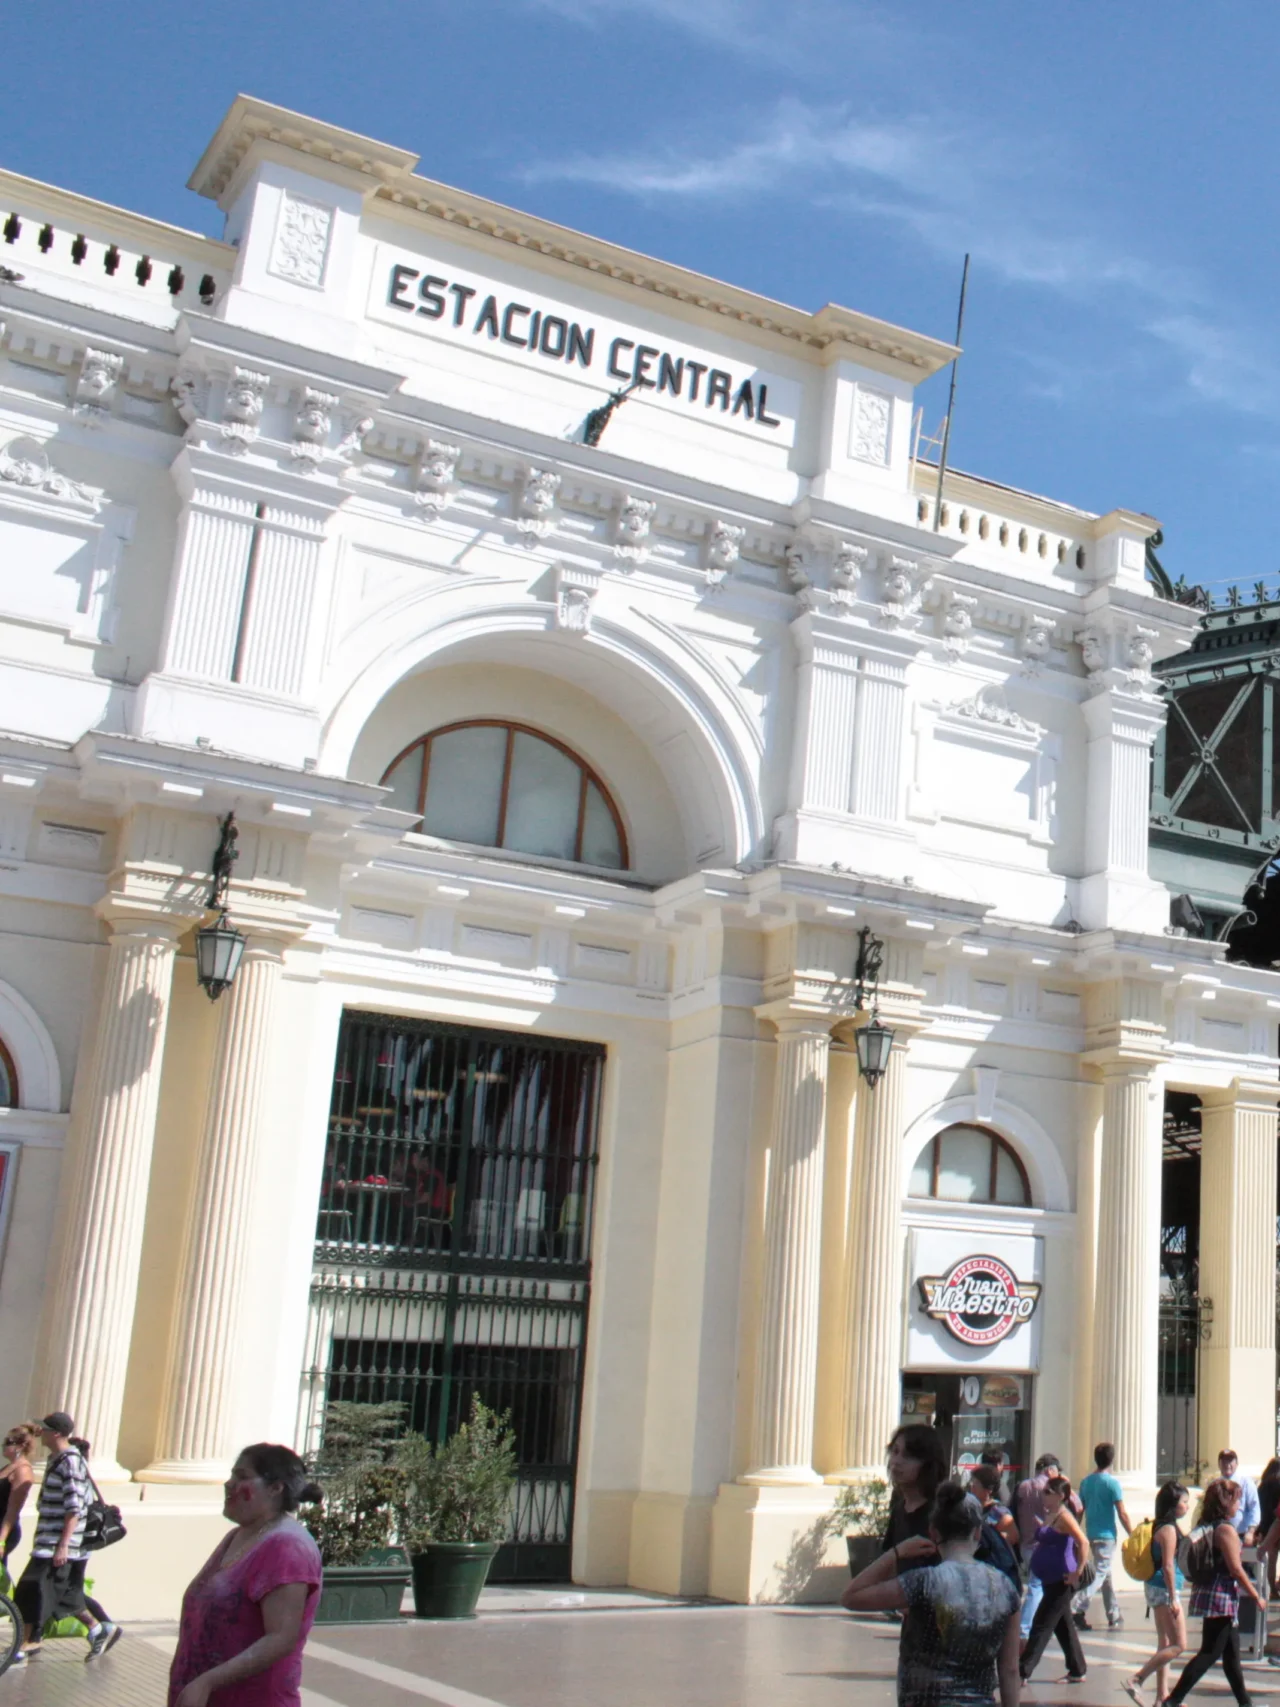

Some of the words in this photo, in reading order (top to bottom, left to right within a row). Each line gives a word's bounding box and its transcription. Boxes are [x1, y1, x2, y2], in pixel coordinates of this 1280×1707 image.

[389, 263, 595, 367] ESTACION
[608, 337, 781, 427] CENTRAL
[952, 1260, 1012, 1286] ESPECIALISTA
[958, 1276, 1004, 1296] Juan
[927, 1285, 1034, 1317] Maestro
[952, 1318, 963, 1330] EN
